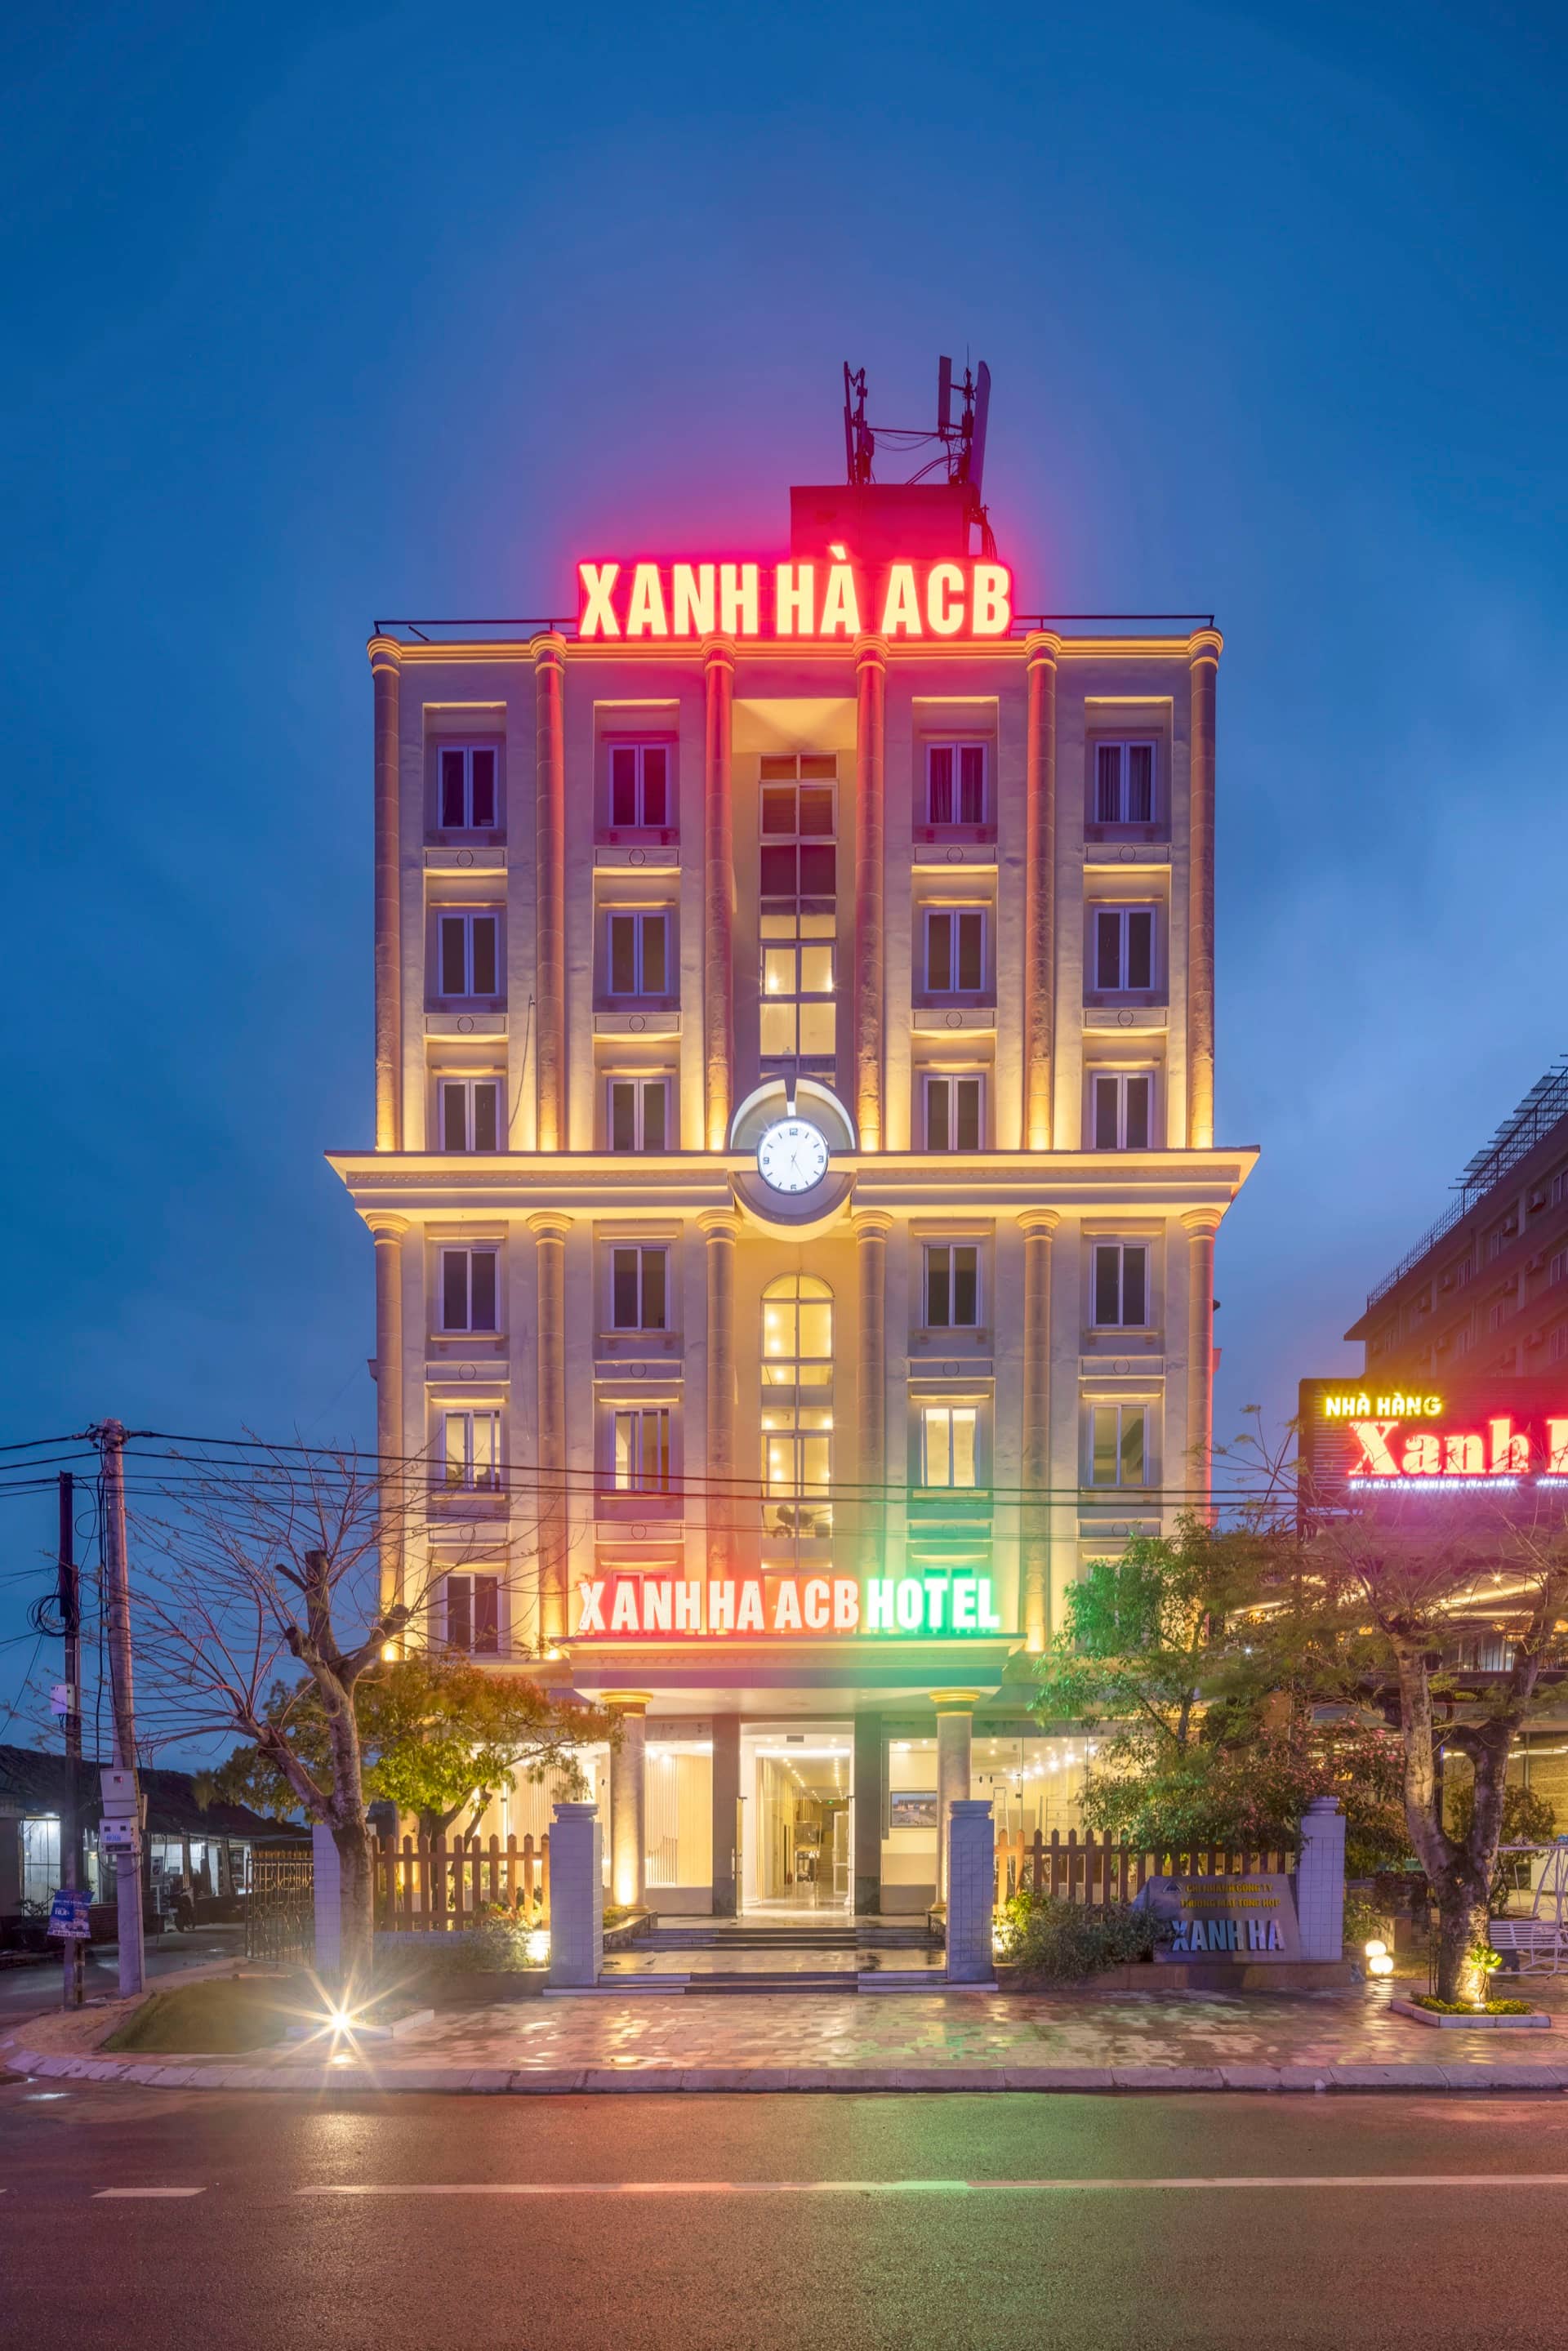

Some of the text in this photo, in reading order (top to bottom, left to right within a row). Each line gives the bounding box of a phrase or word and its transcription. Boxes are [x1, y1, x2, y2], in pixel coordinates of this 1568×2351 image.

[578, 545, 1011, 635] XANH HÀ ACB
[789, 1128, 799, 1136] 12
[763, 1156, 770, 1164] 9
[1325, 1391, 1444, 1417] NHÀ HÀNG
[1348, 1418, 1530, 1476] Xanh
[578, 1578, 1000, 1631] XANH HA ACB HOTEL
[1171, 1920, 1285, 1951] XANH HA
